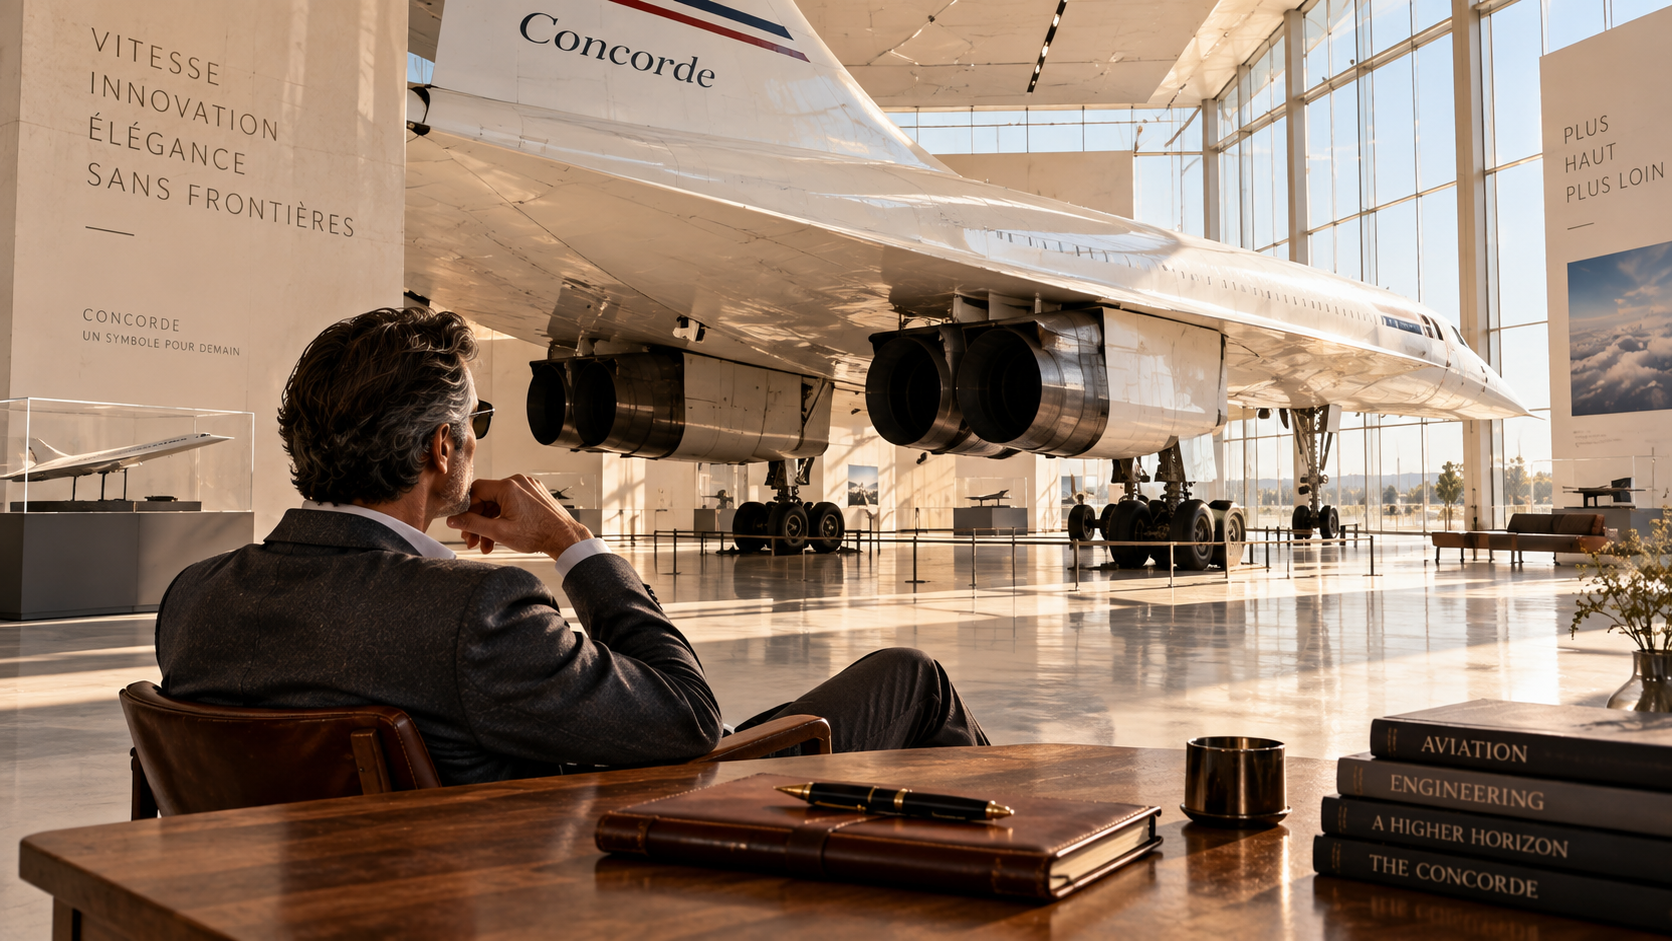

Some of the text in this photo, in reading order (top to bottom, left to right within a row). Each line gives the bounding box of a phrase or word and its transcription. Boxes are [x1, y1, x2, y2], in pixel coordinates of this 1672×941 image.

[91, 27, 219, 86] VITESSE
[519, 12, 715, 88] Concorde
[90, 71, 277, 141] INNOVATION
[89, 112, 245, 175] ÉLÉGANCE
[1564, 115, 1609, 144] PLUS
[1565, 142, 1616, 173] HAUT
[87, 162, 354, 237] SANS FRONTIÈRES
[1566, 161, 1664, 203] PLUS LOIN
[82, 308, 180, 332] CONCORDE
[82, 330, 240, 356] UN SYMBOLE POUR DEMAIN
[1421, 735, 1528, 764] AVIATION
[1390, 773, 1545, 811] ENGINEERING
[1371, 815, 1569, 859] A HIGHER HORIZON
[1369, 854, 1539, 899] THE CONCORDE
